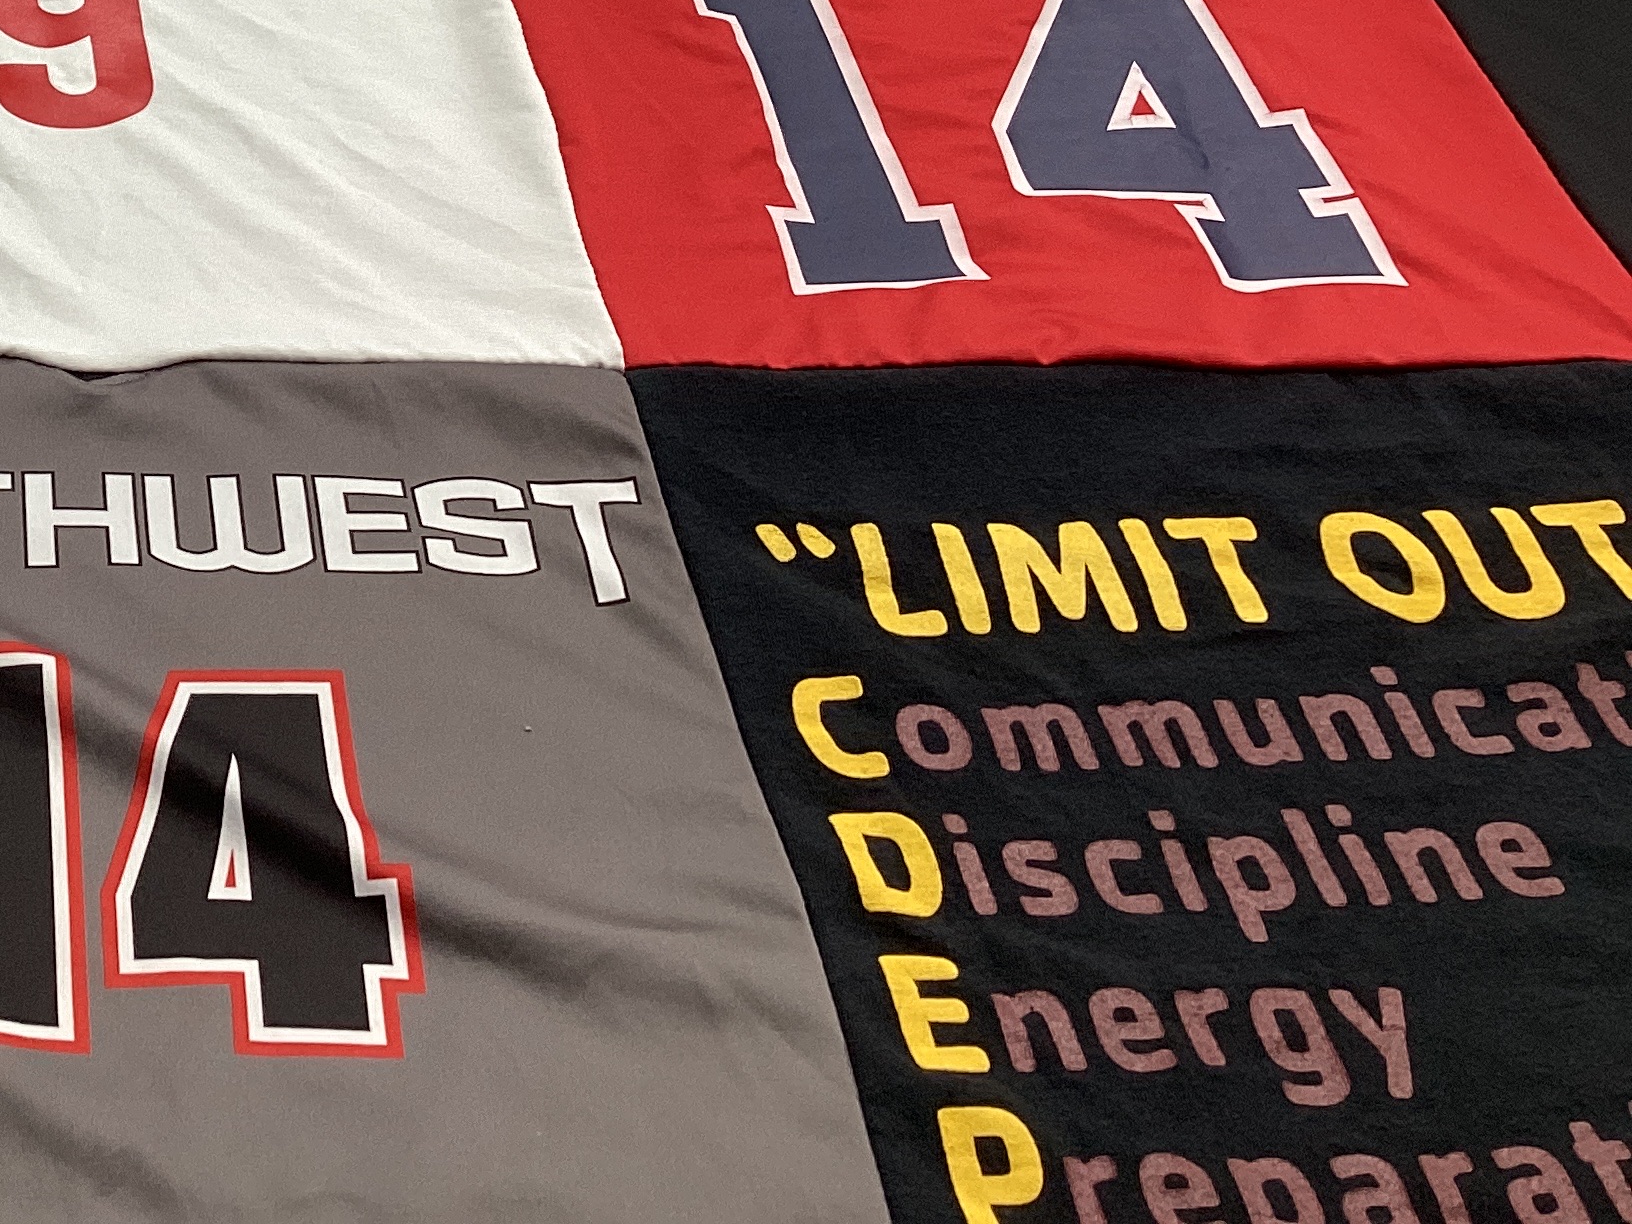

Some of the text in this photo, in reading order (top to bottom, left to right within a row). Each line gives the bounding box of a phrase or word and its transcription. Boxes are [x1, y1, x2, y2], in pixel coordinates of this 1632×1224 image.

[792, 651, 1632, 779] Communicat
[827, 804, 1566, 943] Discipline
[878, 954, 1415, 1107] Energy
[937, 1103, 1632, 1224] Preparat
